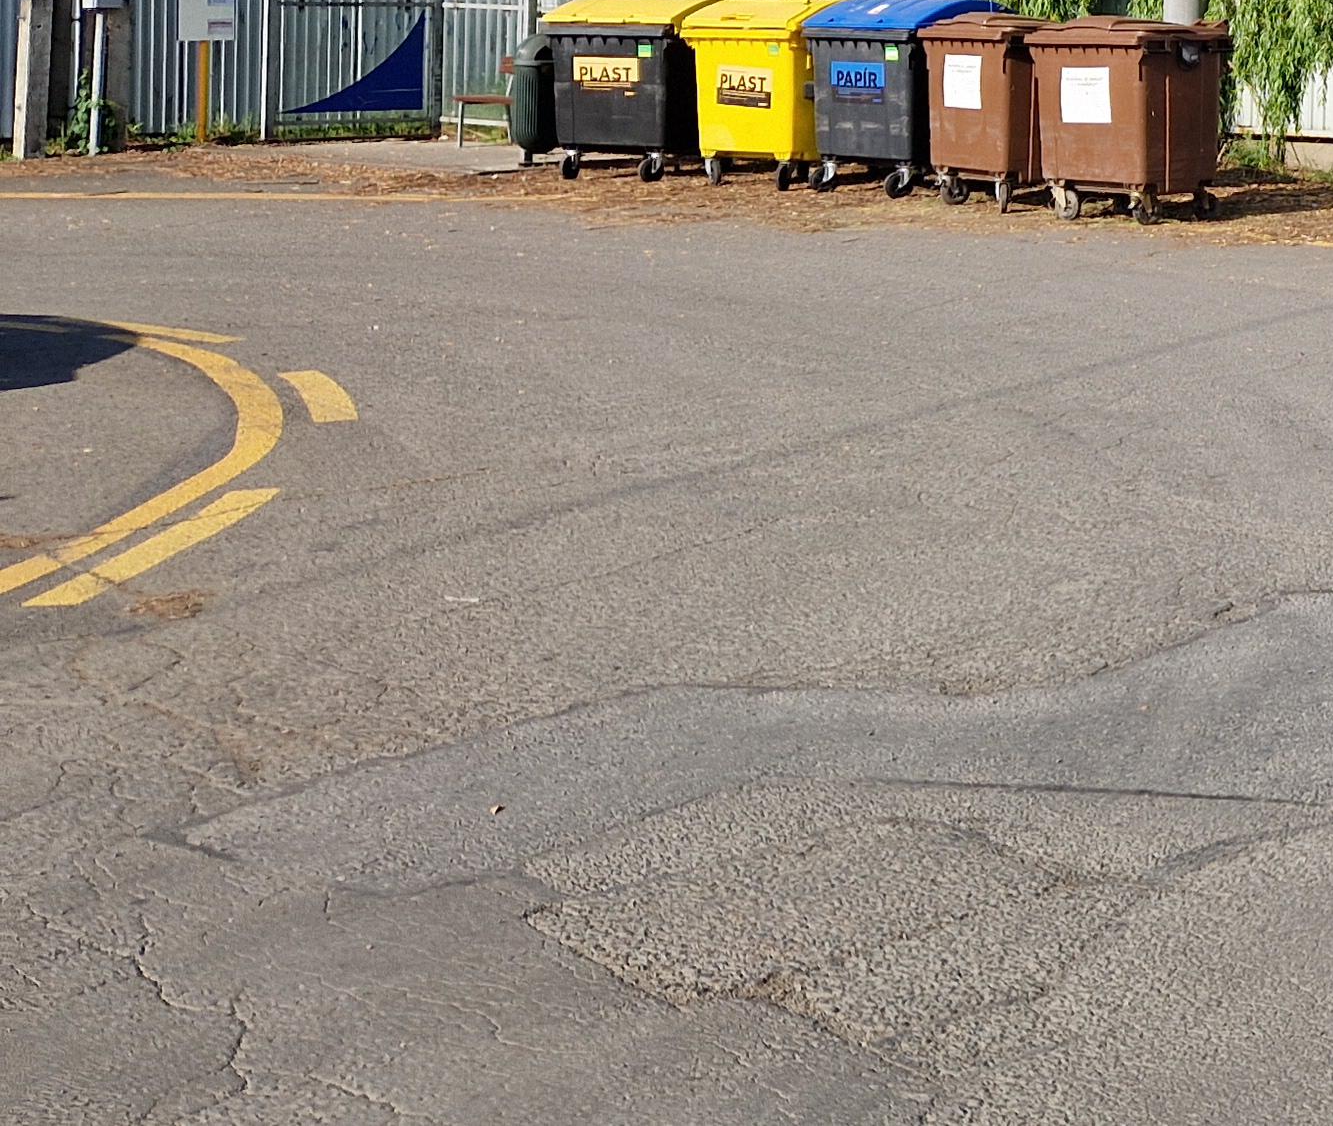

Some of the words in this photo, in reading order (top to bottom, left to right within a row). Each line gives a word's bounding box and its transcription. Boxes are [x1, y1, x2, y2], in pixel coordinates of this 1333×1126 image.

[579, 66, 631, 82] PLAST
[720, 73, 767, 92] PLAST
[836, 67, 878, 88] PAPÍR
